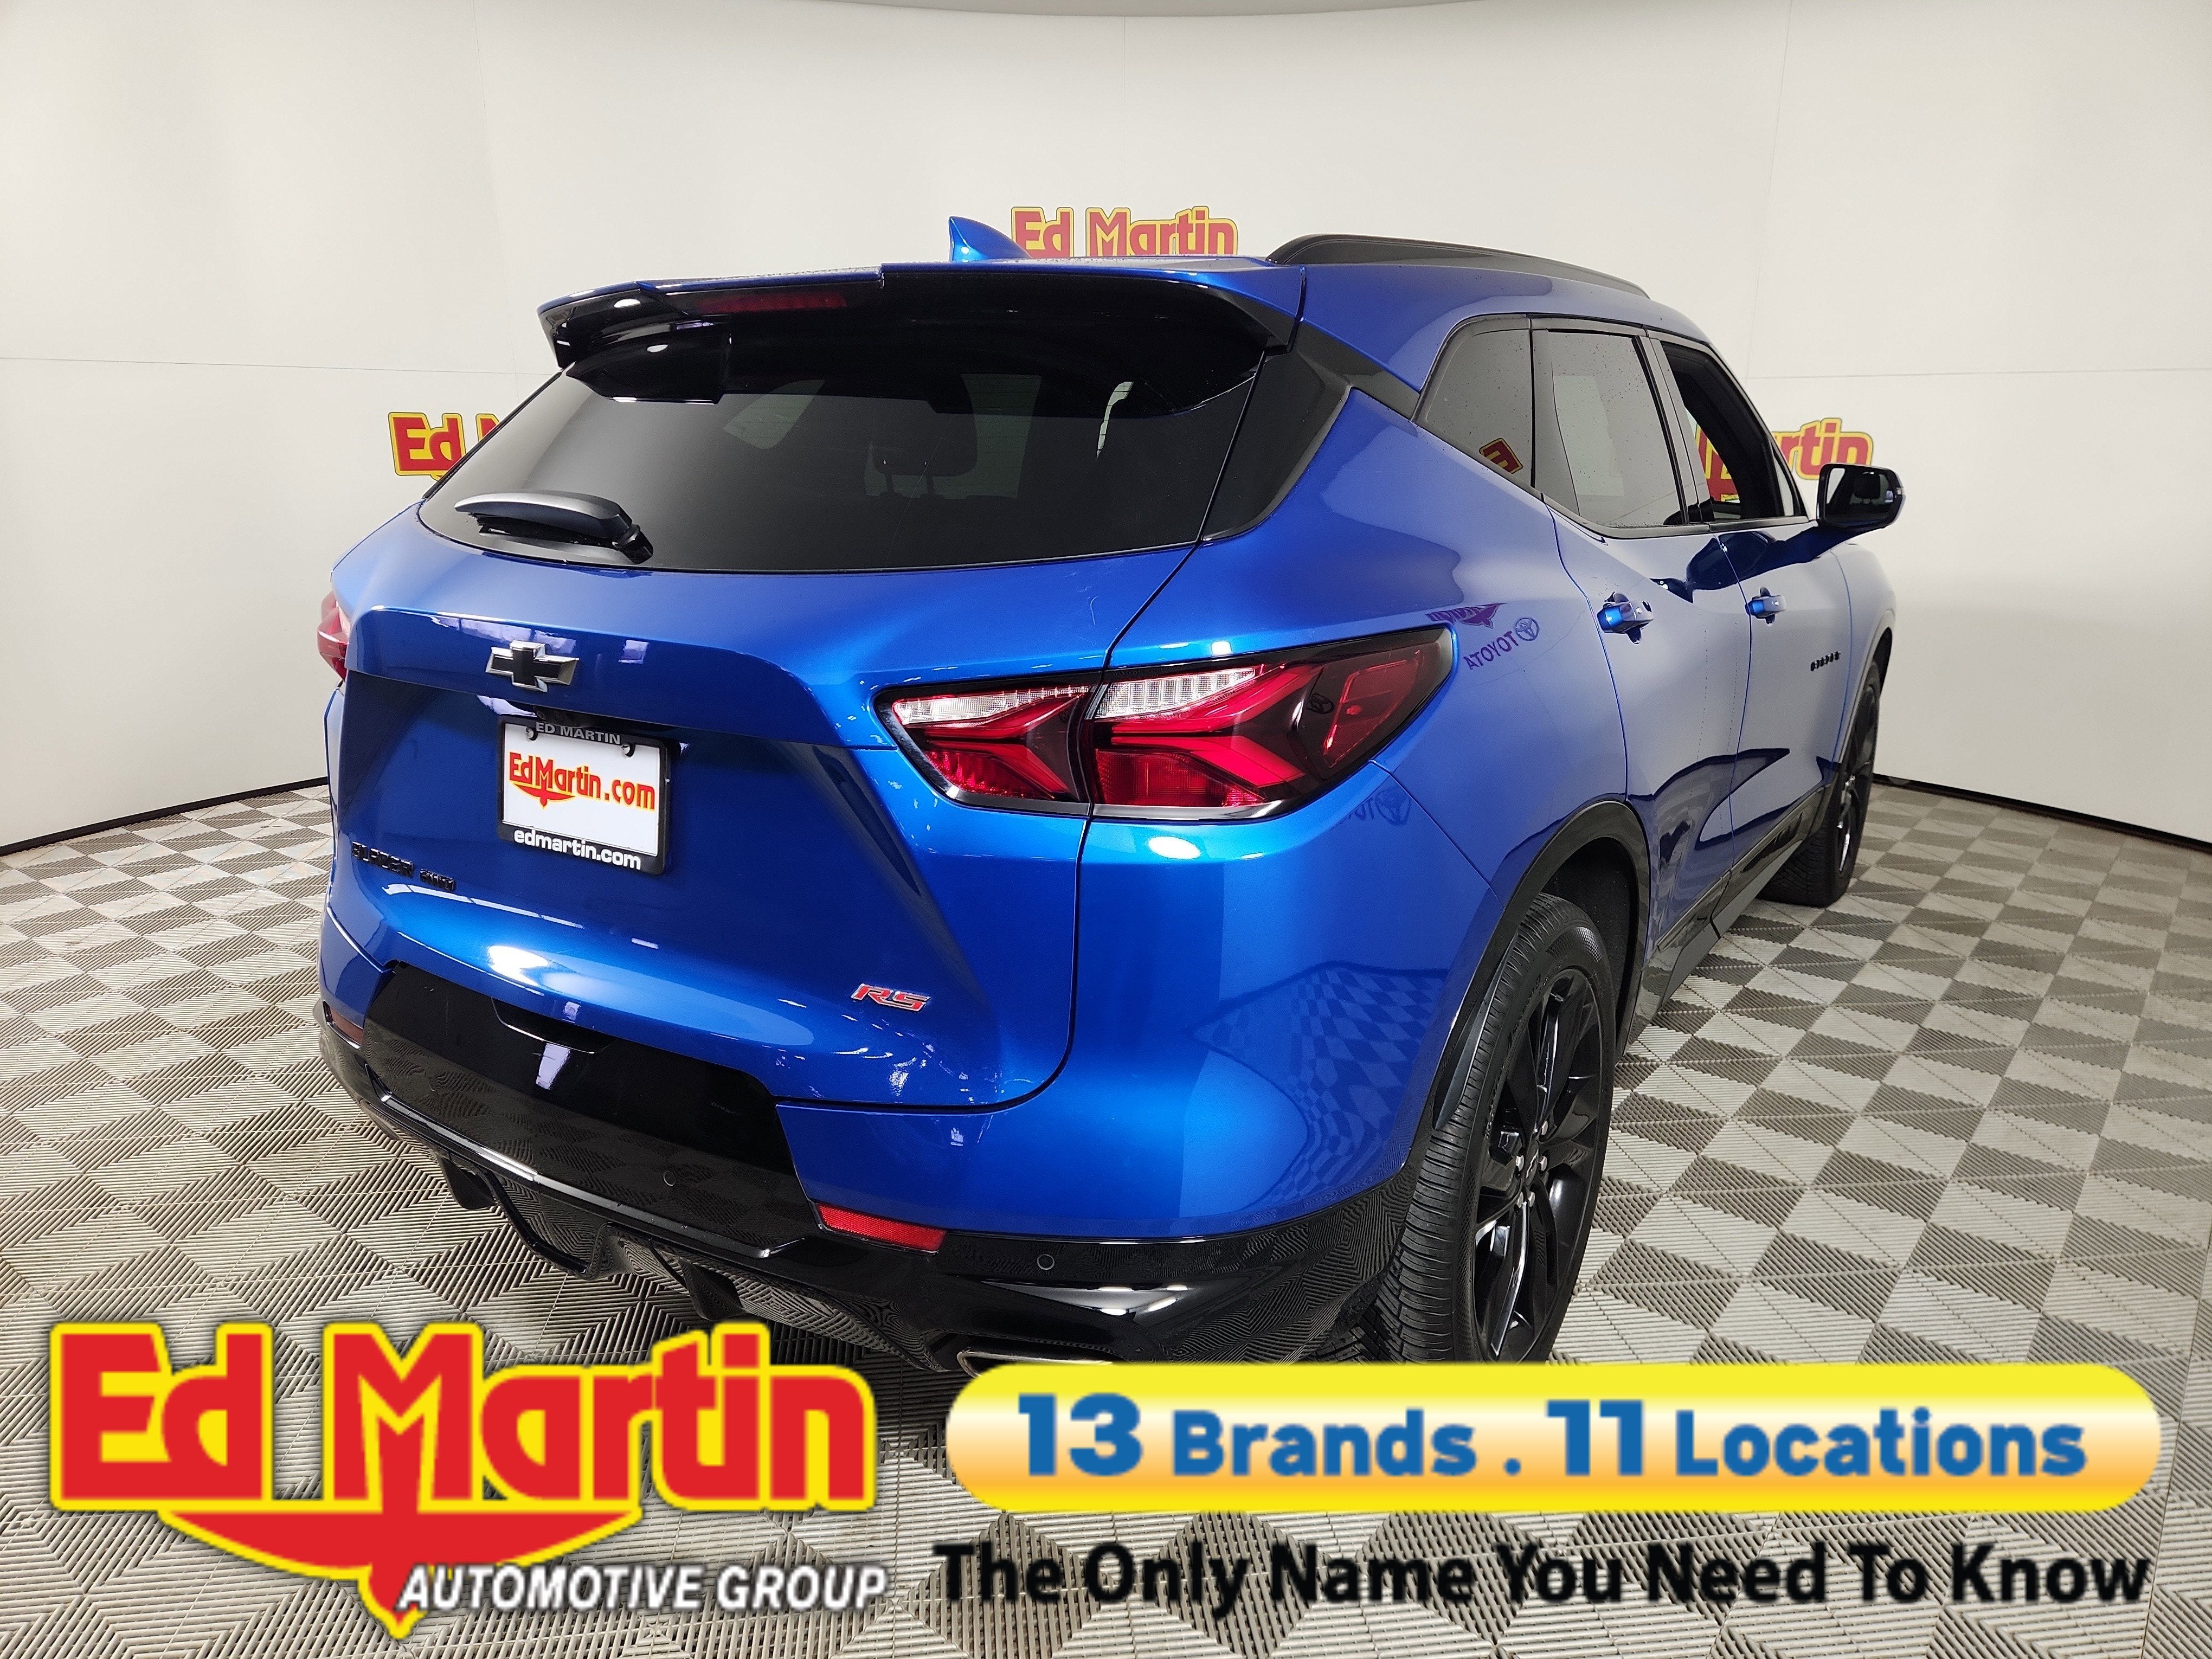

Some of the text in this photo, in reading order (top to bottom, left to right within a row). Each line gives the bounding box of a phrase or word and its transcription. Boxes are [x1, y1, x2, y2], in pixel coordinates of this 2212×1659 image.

[1012, 206, 1237, 257] Ed Martin
[389, 413, 466, 475] Ed
[536, 722, 621, 744] ED MARTIN
[514, 829, 641, 870] edmartin.com
[850, 983, 931, 1012] RS
